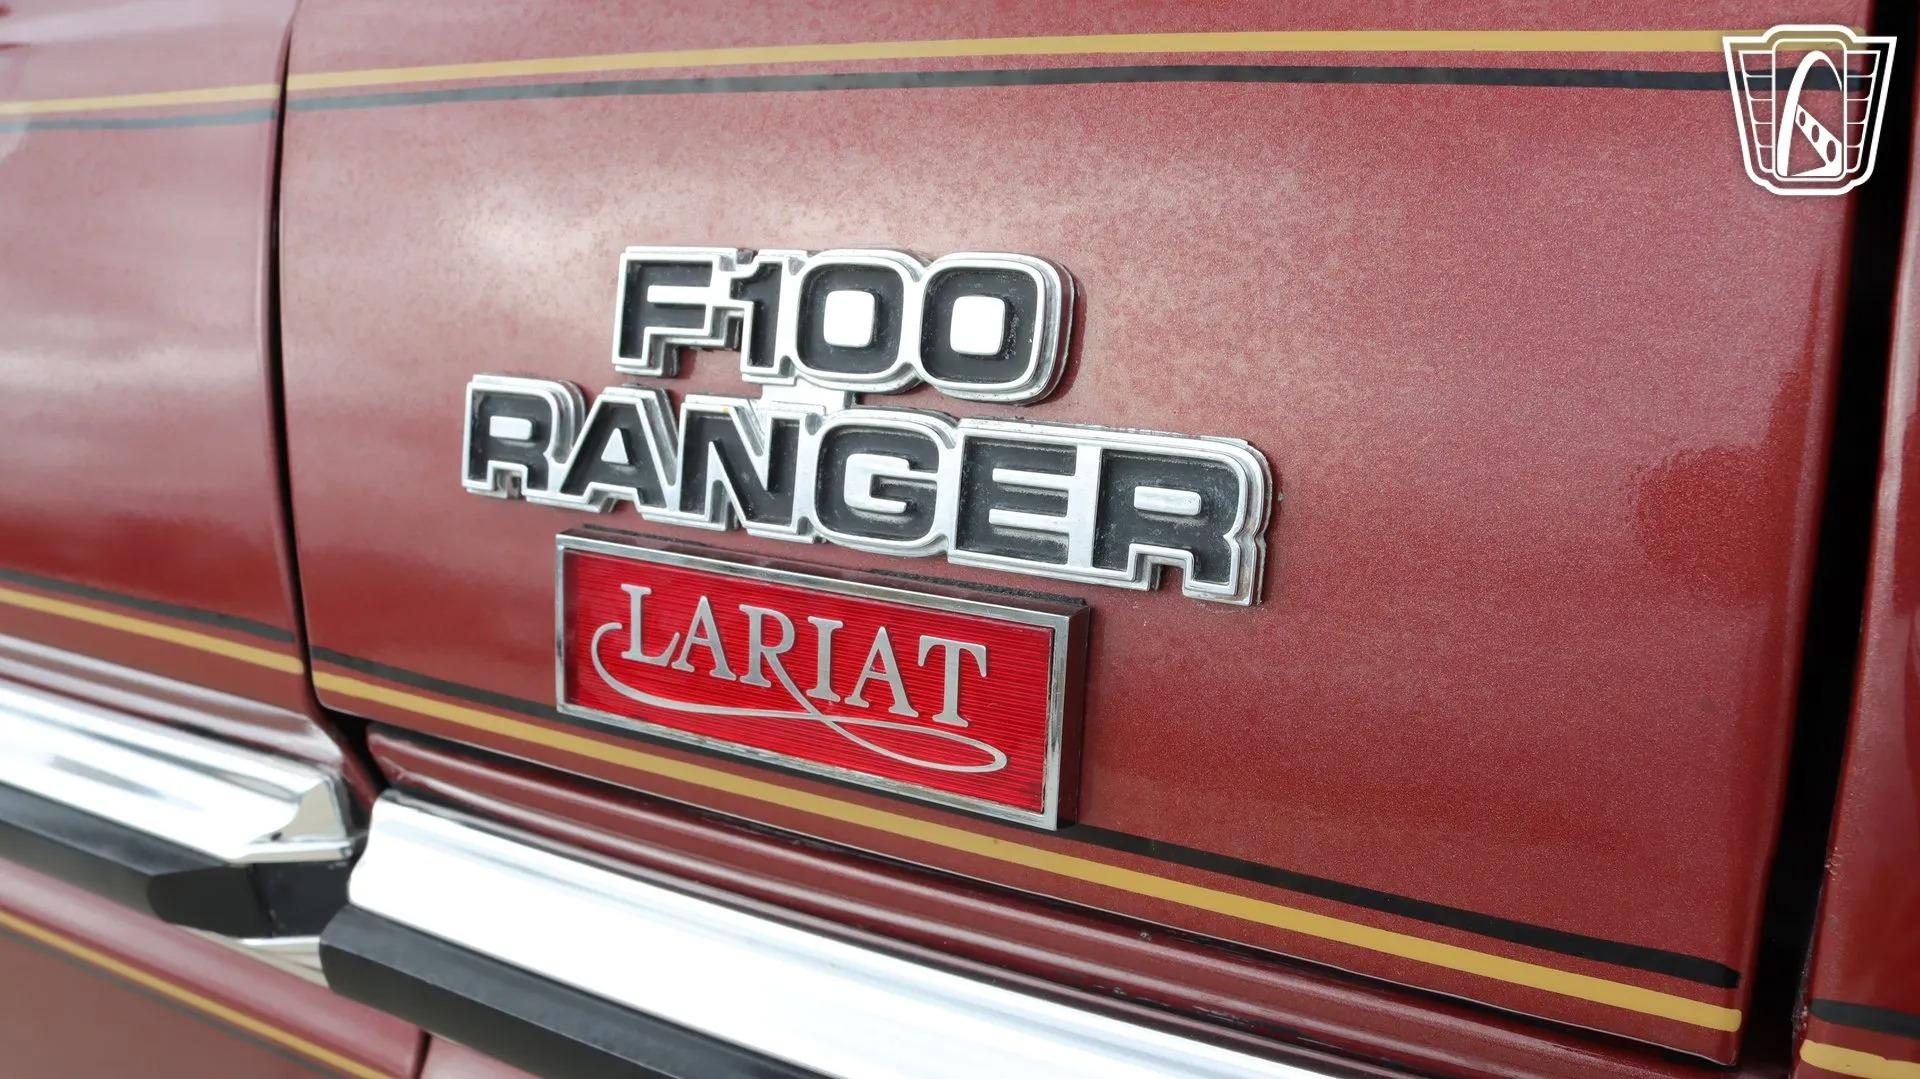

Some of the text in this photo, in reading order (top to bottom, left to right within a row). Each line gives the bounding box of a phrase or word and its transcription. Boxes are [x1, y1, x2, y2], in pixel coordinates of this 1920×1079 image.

[613, 249, 1054, 400] F100
[462, 377, 1264, 605] RANGER
[614, 583, 992, 735] LARIAT
